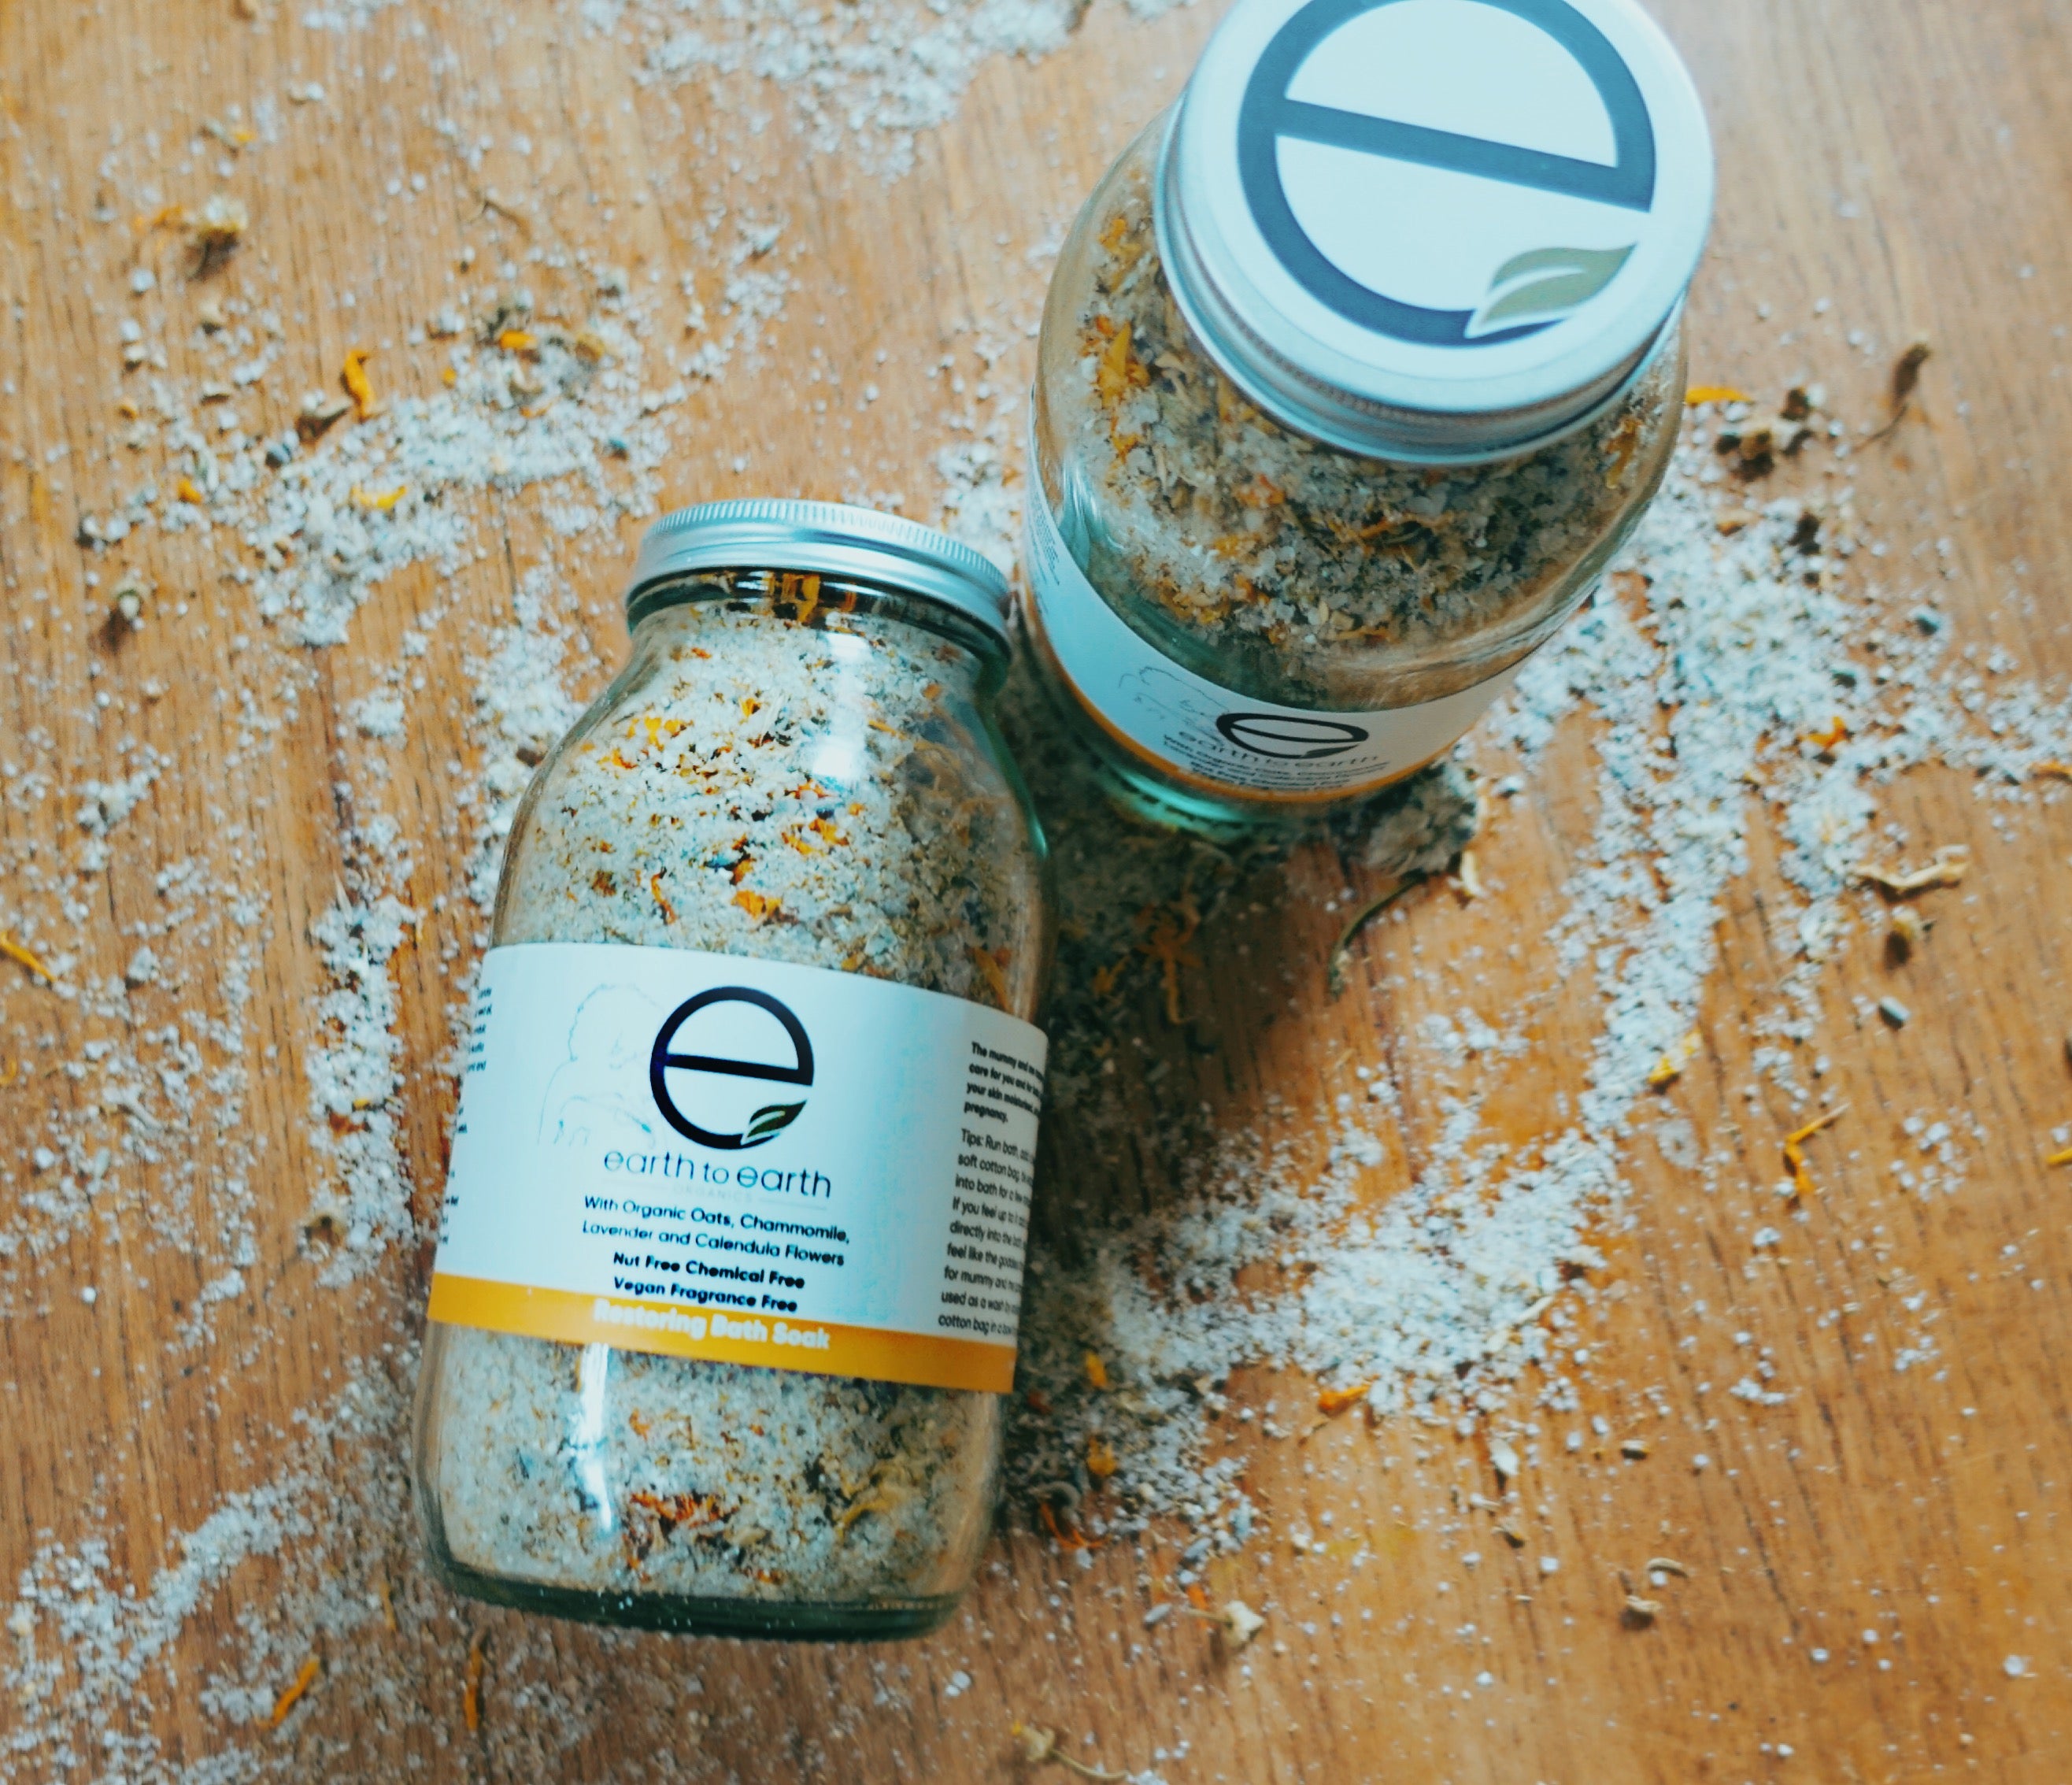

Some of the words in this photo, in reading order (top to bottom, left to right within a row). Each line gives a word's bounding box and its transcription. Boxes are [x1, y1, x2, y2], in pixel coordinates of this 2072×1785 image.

[971, 1040, 987, 1057] The
[969, 1063, 989, 1077] care
[967, 1083, 986, 1094] your
[961, 1128, 983, 1147] Tips:
[985, 1135, 1001, 1151] Run
[605, 1151, 694, 1180] earth
[704, 1163, 729, 1184] to
[737, 1165, 831, 1198] earth
[957, 1154, 978, 1168] soft
[979, 1159, 1007, 1176] cotton
[955, 1173, 975, 1191] into
[977, 1178, 998, 1196] bath
[585, 1194, 618, 1211] With
[623, 1199, 686, 1220] Organic
[690, 1207, 734, 1229] Oats,
[741, 1213, 849, 1245] Chammomile,
[962, 1201, 980, 1217] you
[949, 1220, 986, 1242] directly
[583, 1220, 653, 1239] Lavender
[659, 1232, 690, 1245] and
[695, 1233, 780, 1257] Calendula
[786, 1244, 845, 1266] Flowers
[947, 1242, 967, 1259] feel
[613, 1252, 640, 1267] Nut
[646, 1255, 680, 1272] Free
[686, 1260, 764, 1283] Chemical
[768, 1270, 805, 1289] Free
[945, 1265, 959, 1281] for
[614, 1276, 665, 1296] Vegan
[671, 1283, 757, 1307] Fragrance
[761, 1294, 797, 1312] Free
[941, 1291, 968, 1305] used
[594, 1298, 707, 1340] Restoring
[710, 1313, 768, 1342] Bath
[772, 1322, 830, 1350] Soak
[938, 1314, 971, 1329] cotton
